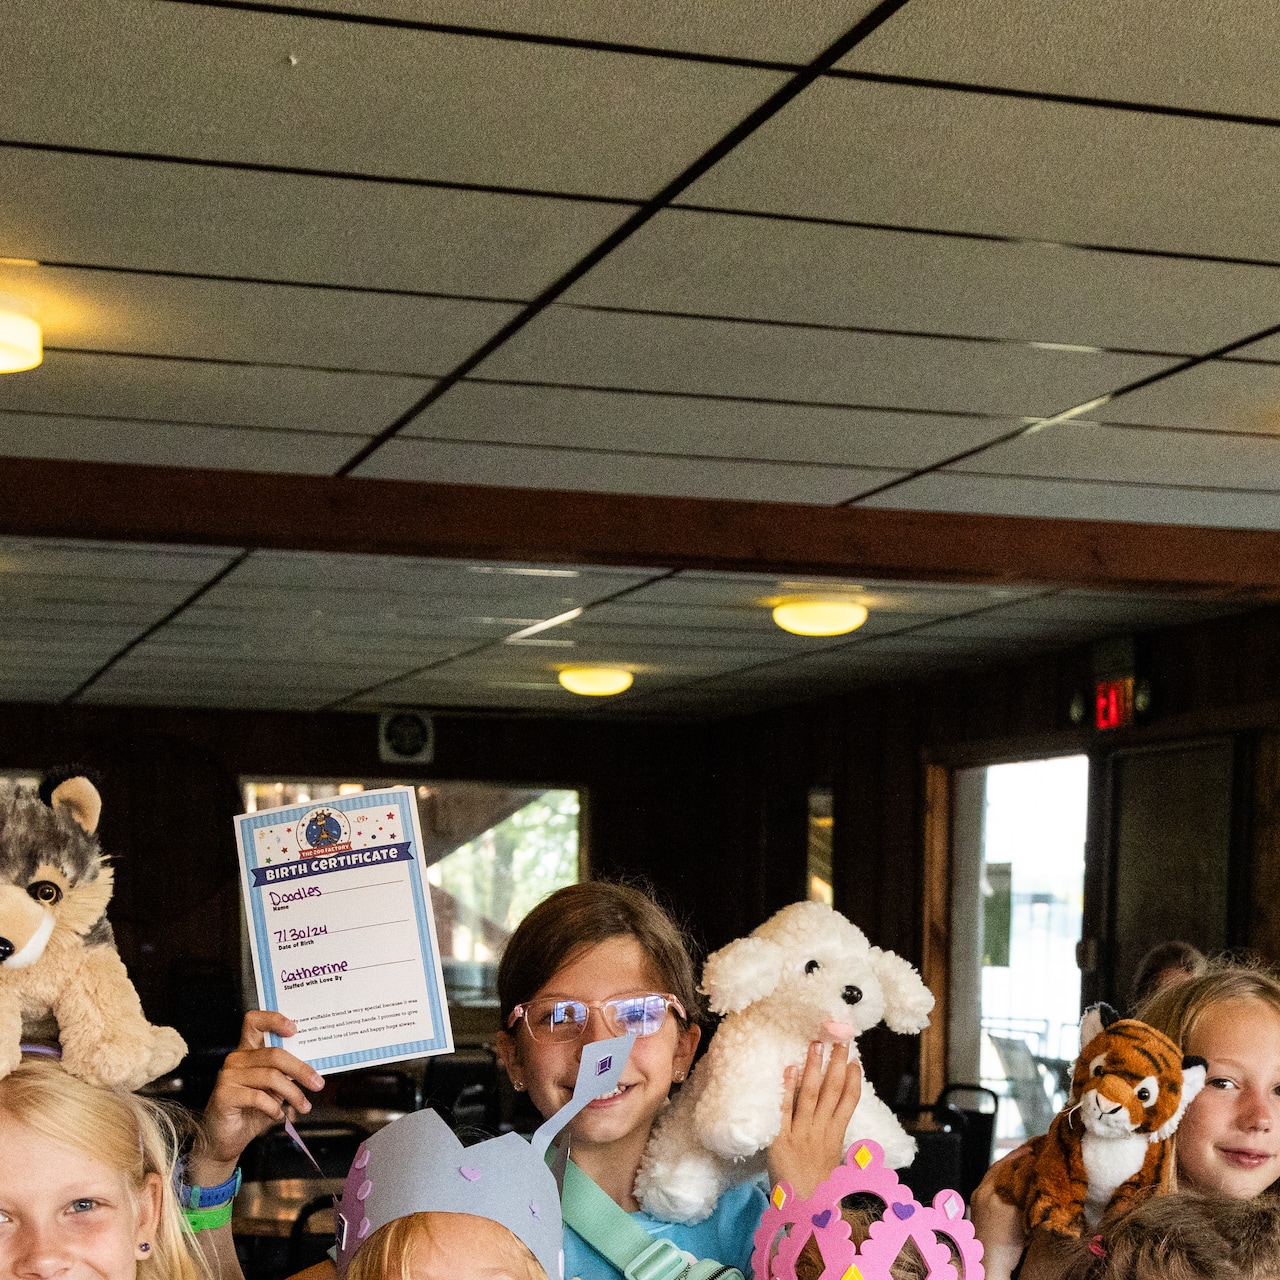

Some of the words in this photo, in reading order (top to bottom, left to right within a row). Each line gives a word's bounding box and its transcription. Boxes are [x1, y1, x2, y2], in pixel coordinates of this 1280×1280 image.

[266, 863, 307, 880] BIRTH
[269, 886, 322, 906] Doodles
[274, 925, 328, 942] 7/30/24
[281, 961, 348, 982] Catherine
